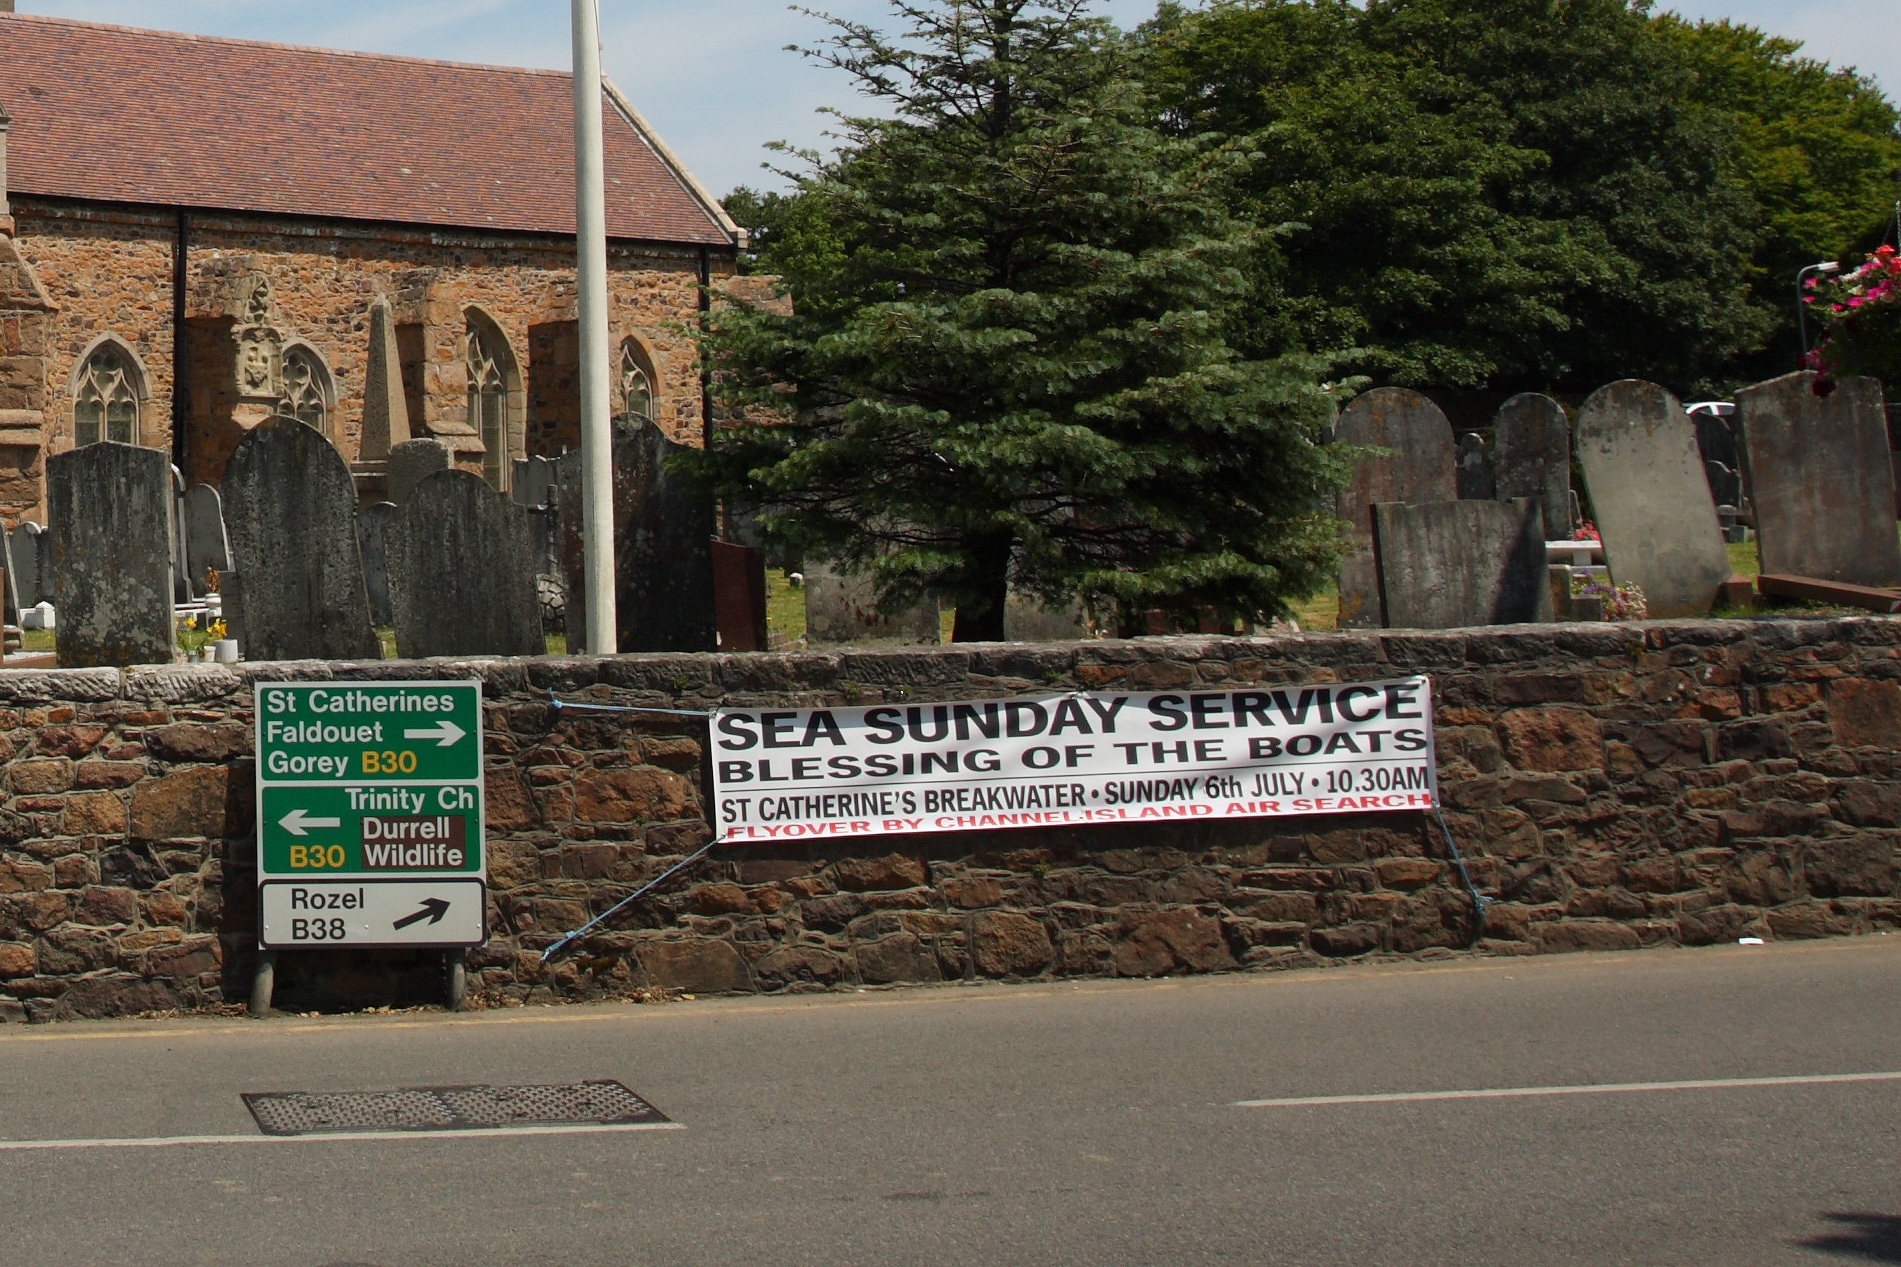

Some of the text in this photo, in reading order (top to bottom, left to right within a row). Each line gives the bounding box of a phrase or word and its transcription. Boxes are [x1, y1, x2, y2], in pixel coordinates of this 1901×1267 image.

[266, 689, 455, 714] St Catherines
[717, 683, 1423, 751] SEA SUNDAY SERVICE
[266, 720, 384, 744] Faldouet
[267, 750, 418, 777] Gorey B30
[718, 728, 1428, 784] BLESSING OF THE BOATS
[344, 786, 474, 814] Trinity Ch
[721, 765, 1430, 823] ST CATHERINE'S BREAKWATER SUNDAY 6th JULY 10.30AM
[363, 816, 451, 840] Durrell
[726, 793, 1433, 839] FLYOVER BY CHANNEL ISLAND AIR SEARCH
[289, 844, 346, 869] B30
[364, 843, 463, 867] Wildlife
[291, 887, 364, 910] Rozel
[291, 917, 346, 941] B38
